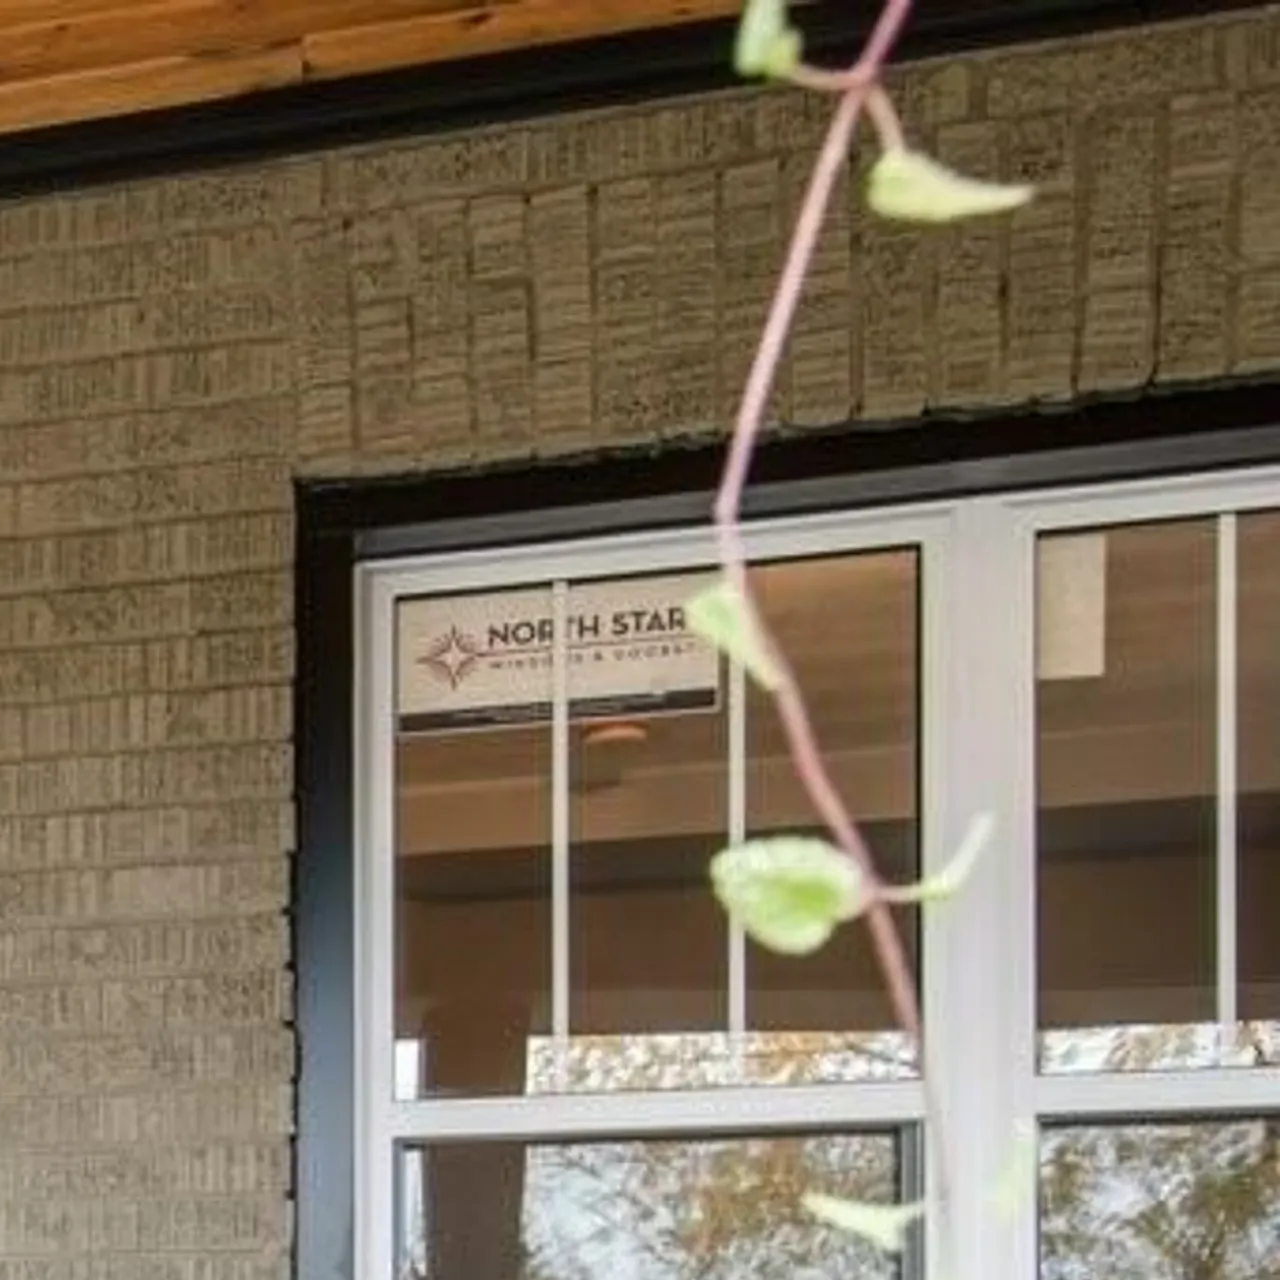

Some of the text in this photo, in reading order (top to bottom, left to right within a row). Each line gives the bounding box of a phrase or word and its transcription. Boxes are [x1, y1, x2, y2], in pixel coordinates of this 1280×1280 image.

[488, 606, 686, 648] NORTH STAR
[489, 650, 584, 670] WINDOS
